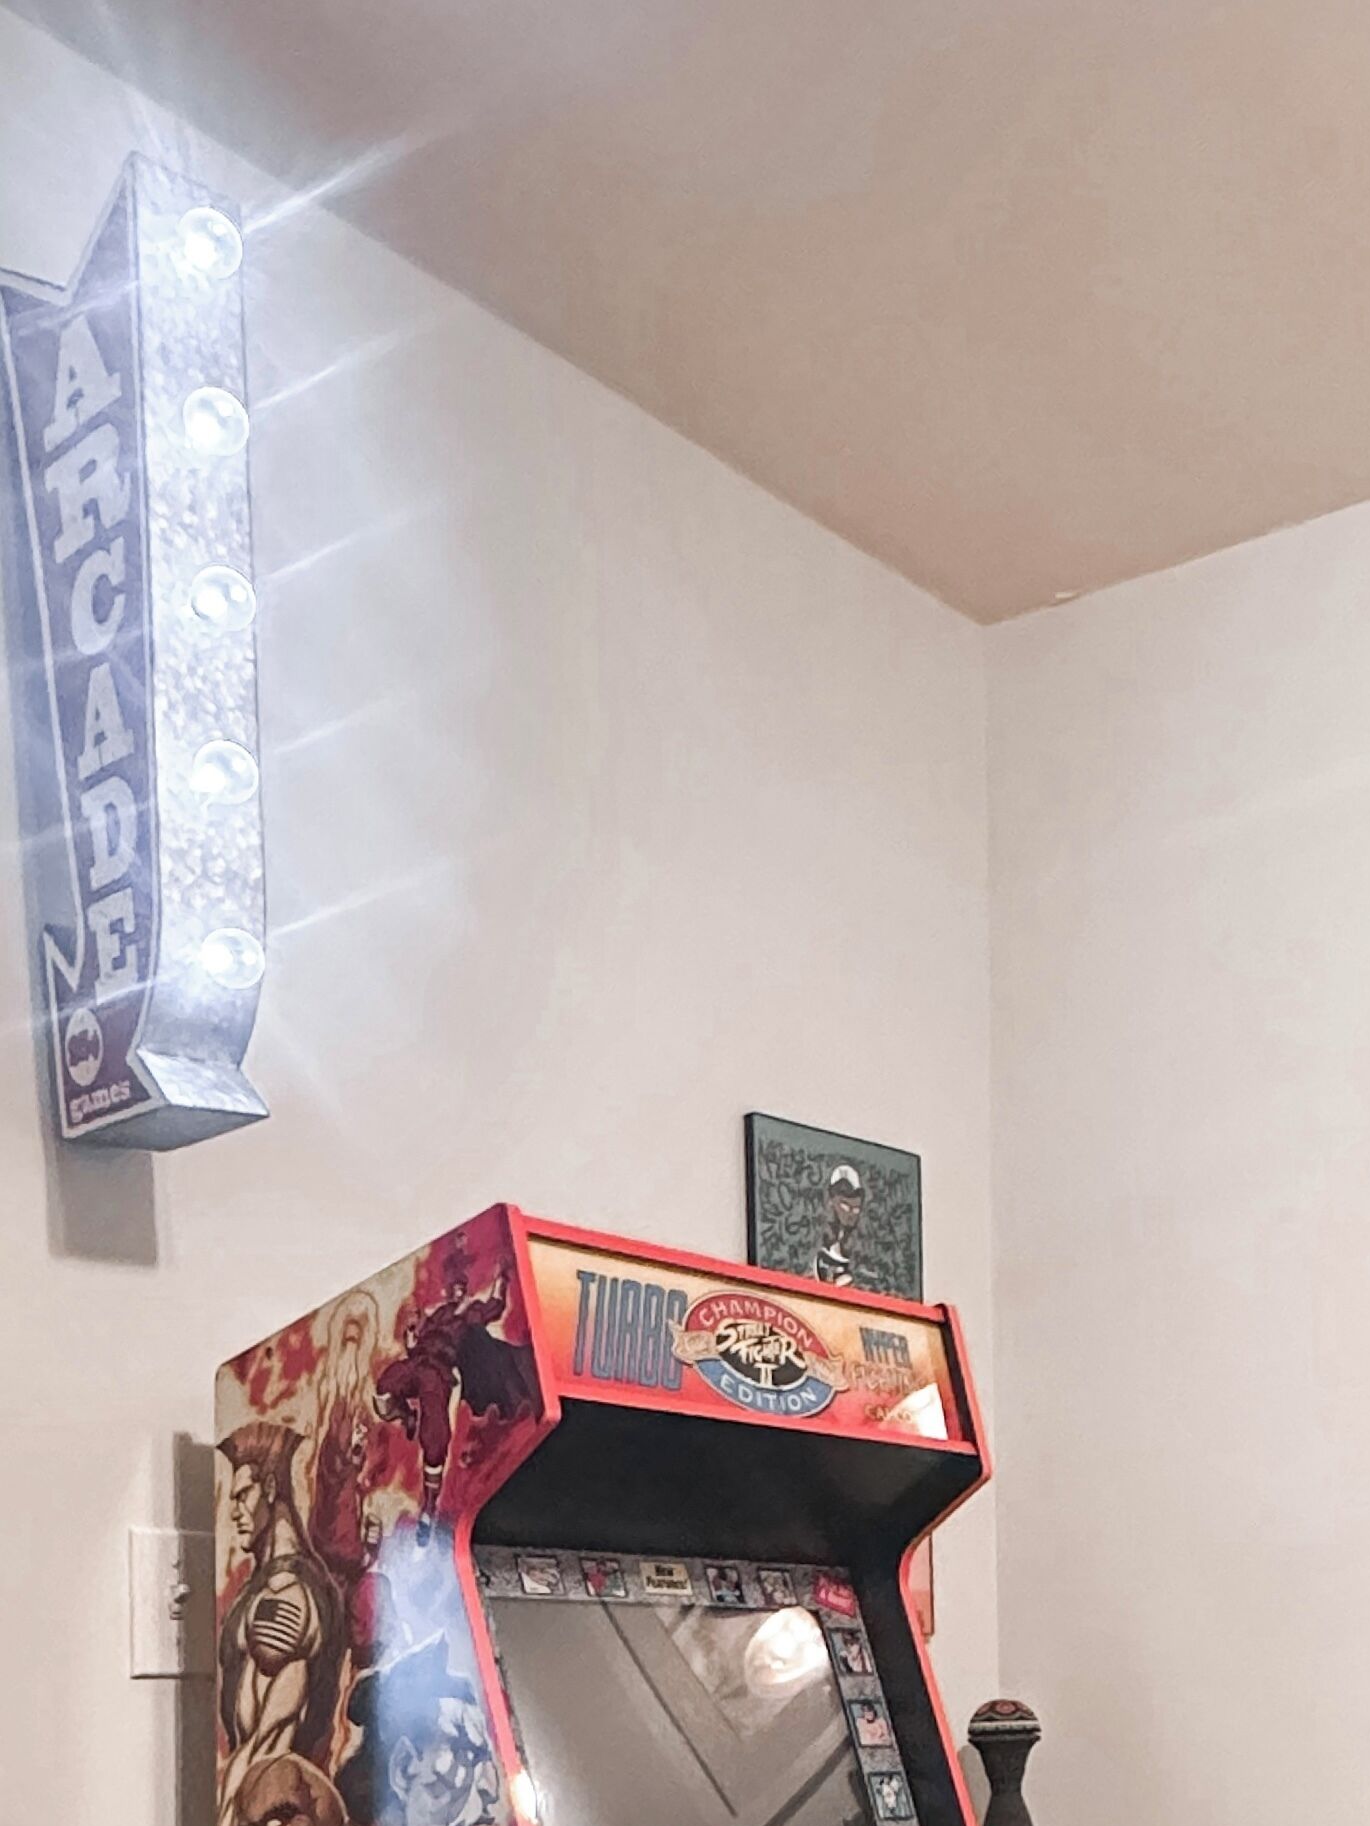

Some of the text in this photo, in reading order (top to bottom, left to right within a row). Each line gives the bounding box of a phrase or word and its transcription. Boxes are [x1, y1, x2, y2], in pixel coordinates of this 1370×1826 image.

[42, 314, 138, 1004] ARCADE
[573, 1270, 688, 1391] TURBO
[699, 1300, 813, 1348] CHAMPION
[720, 1375, 818, 1411] EDITION
